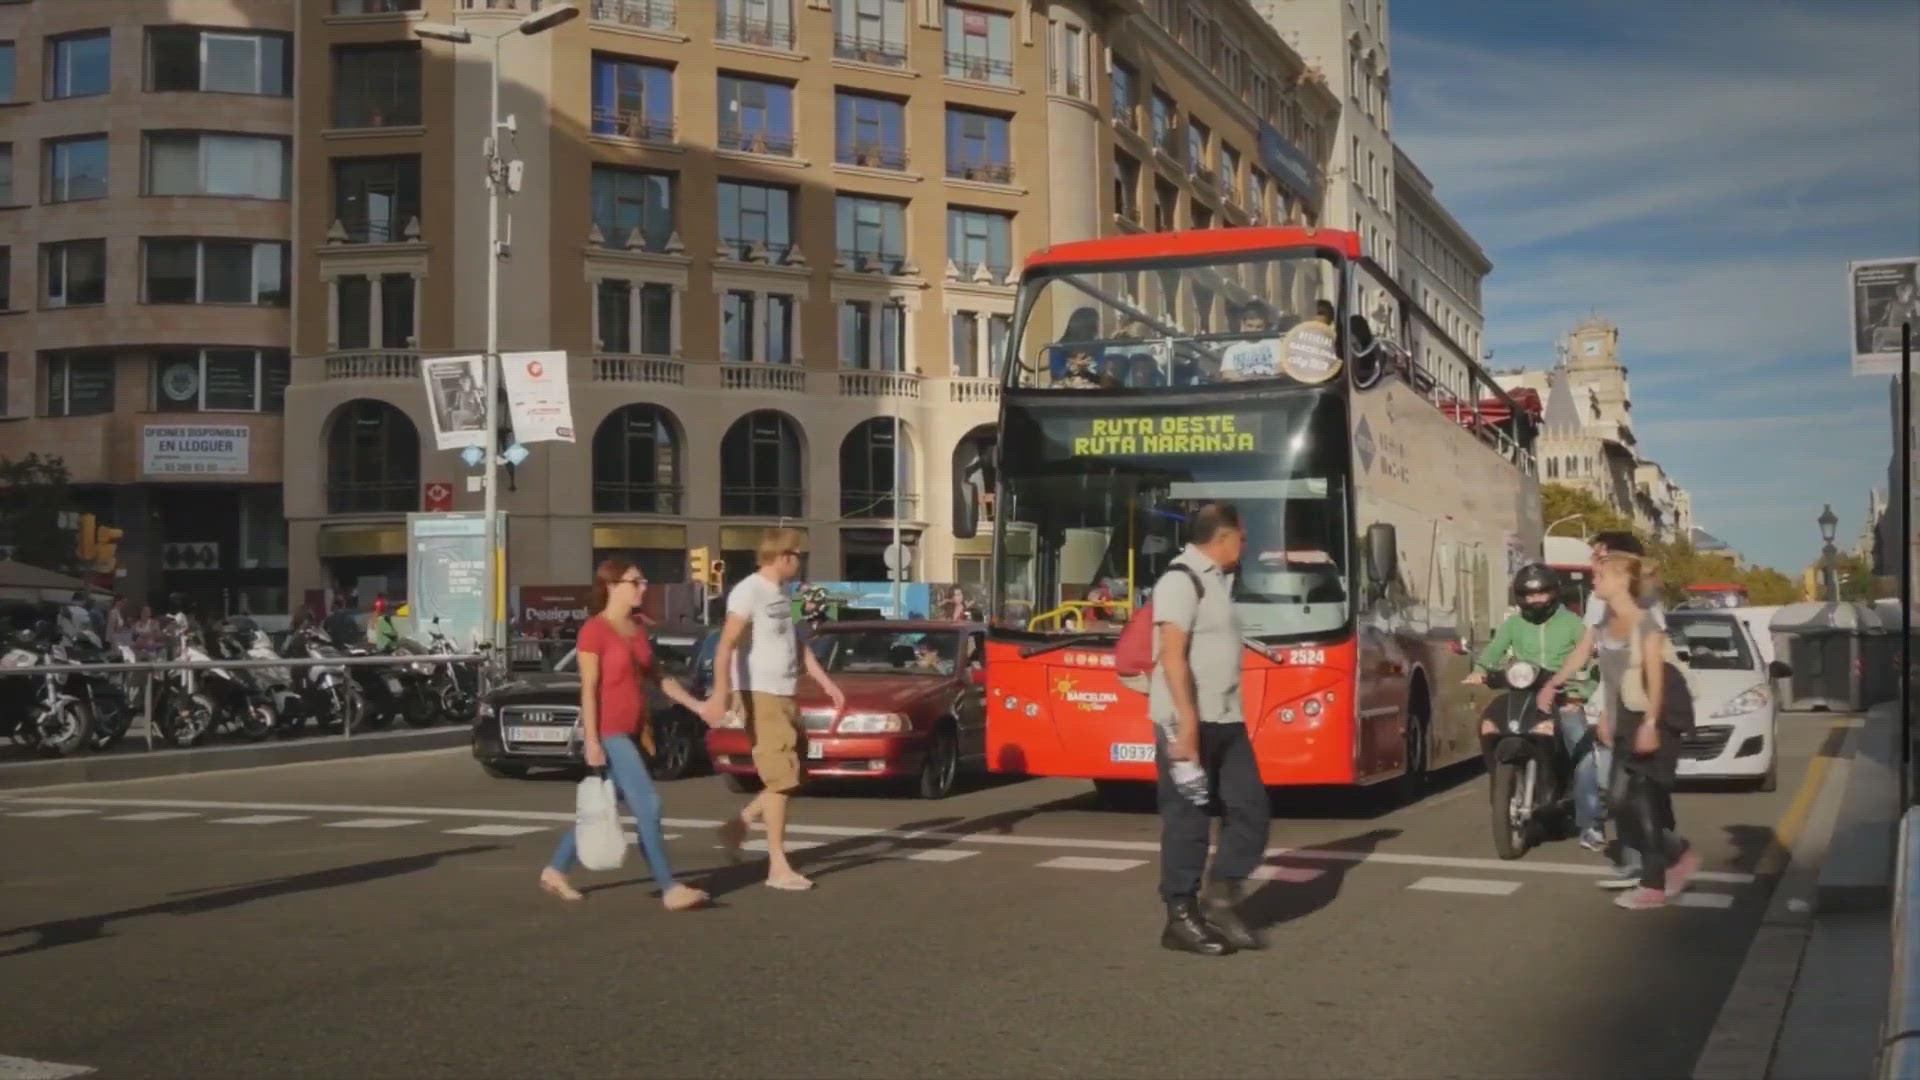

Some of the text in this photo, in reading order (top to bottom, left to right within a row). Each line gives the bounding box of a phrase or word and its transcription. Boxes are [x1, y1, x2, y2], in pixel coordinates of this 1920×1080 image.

[144, 427, 248, 438] OFICINES DISPONIBLES
[1092, 415, 1236, 436] RUTA OESTE
[159, 440, 233, 453] EN LLOGUER
[1075, 433, 1254, 455] RUTA NARANJA
[1290, 649, 1325, 665] 2524
[1066, 690, 1119, 703] BARCELONA
